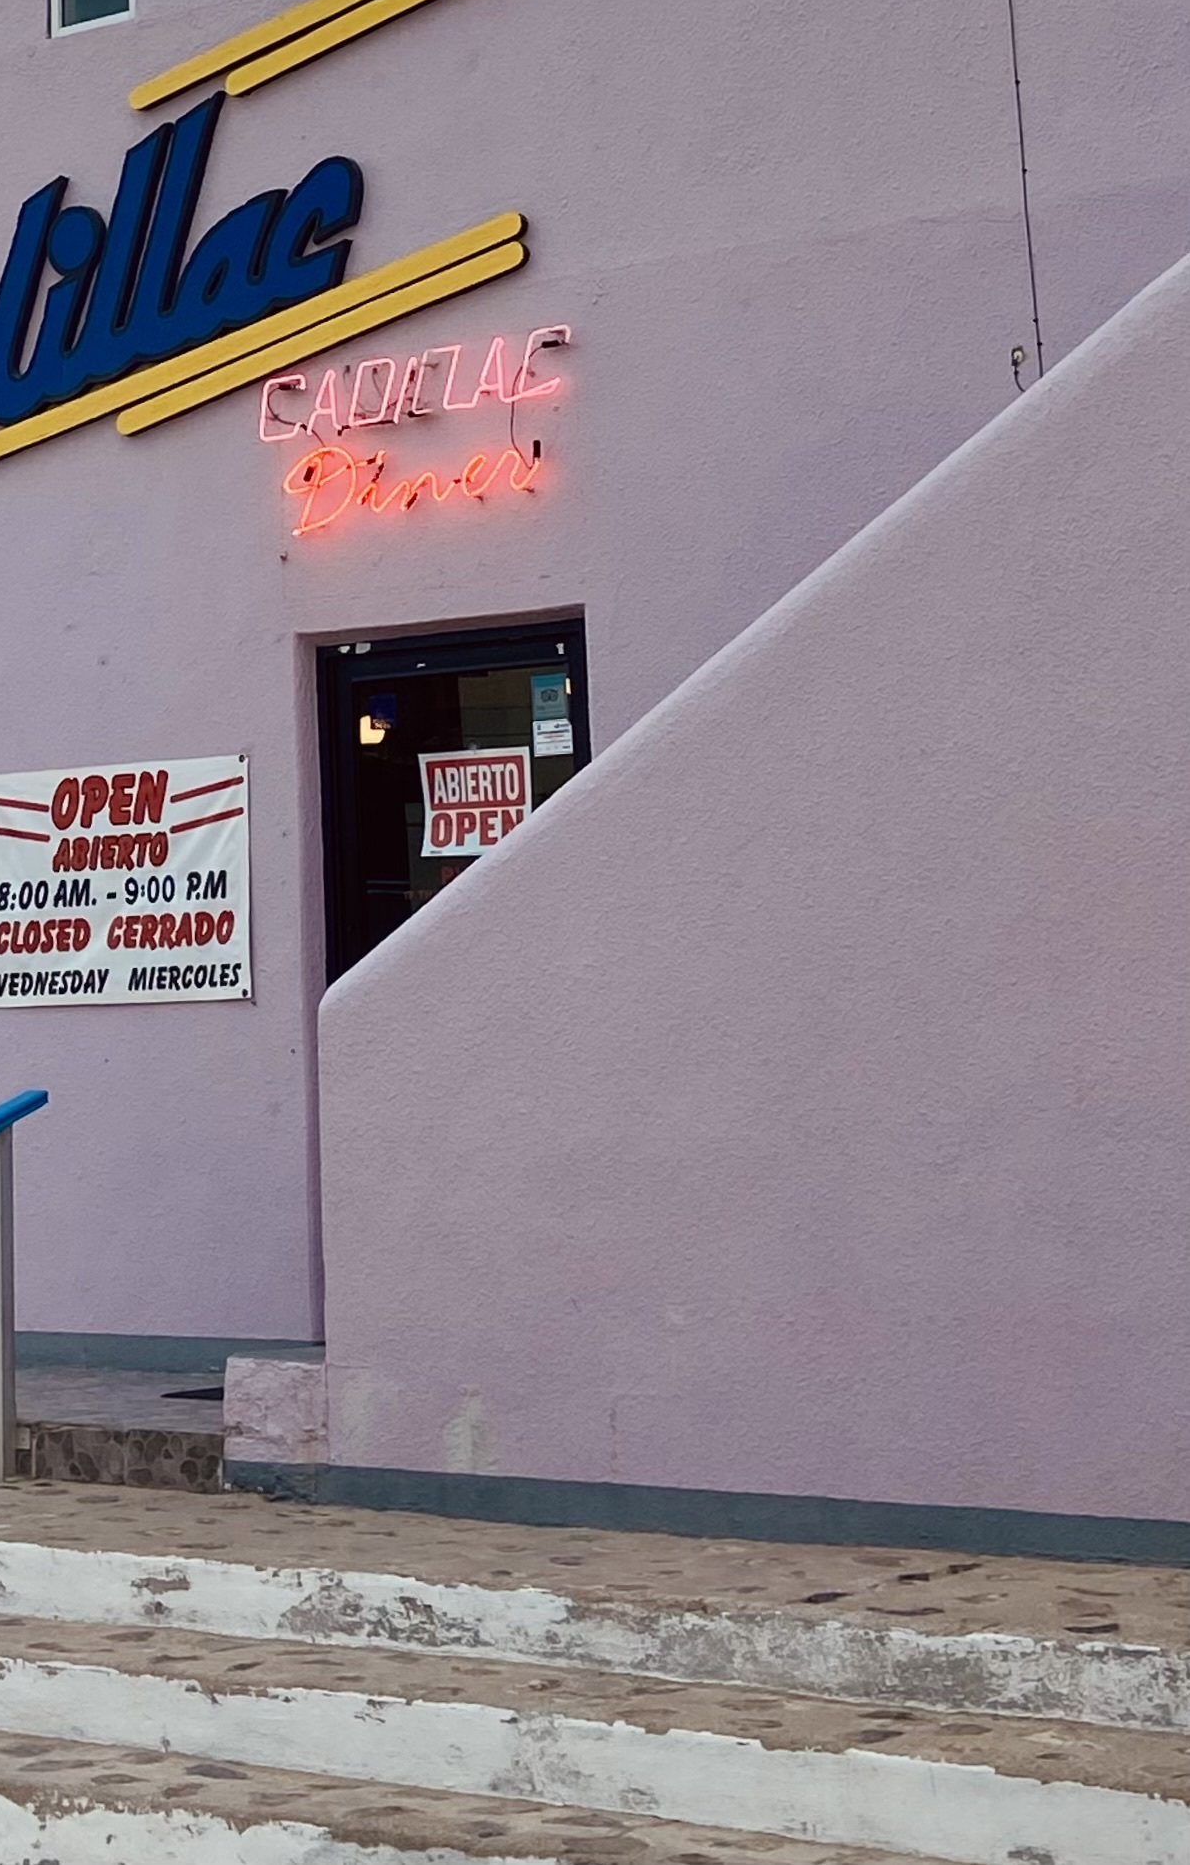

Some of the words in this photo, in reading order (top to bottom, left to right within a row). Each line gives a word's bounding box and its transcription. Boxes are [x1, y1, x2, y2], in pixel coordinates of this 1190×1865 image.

[283, 447, 541, 536] Diner
[51, 770, 169, 830] OPEN
[433, 762, 520, 805] ABIERTO
[430, 808, 524, 848] OPEN
[52, 831, 169, 873] ABIERTO
[124, 875, 176, 905] 9:00
[106, 910, 235, 951] CERRADO
[128, 963, 242, 992] MIERCOLES
